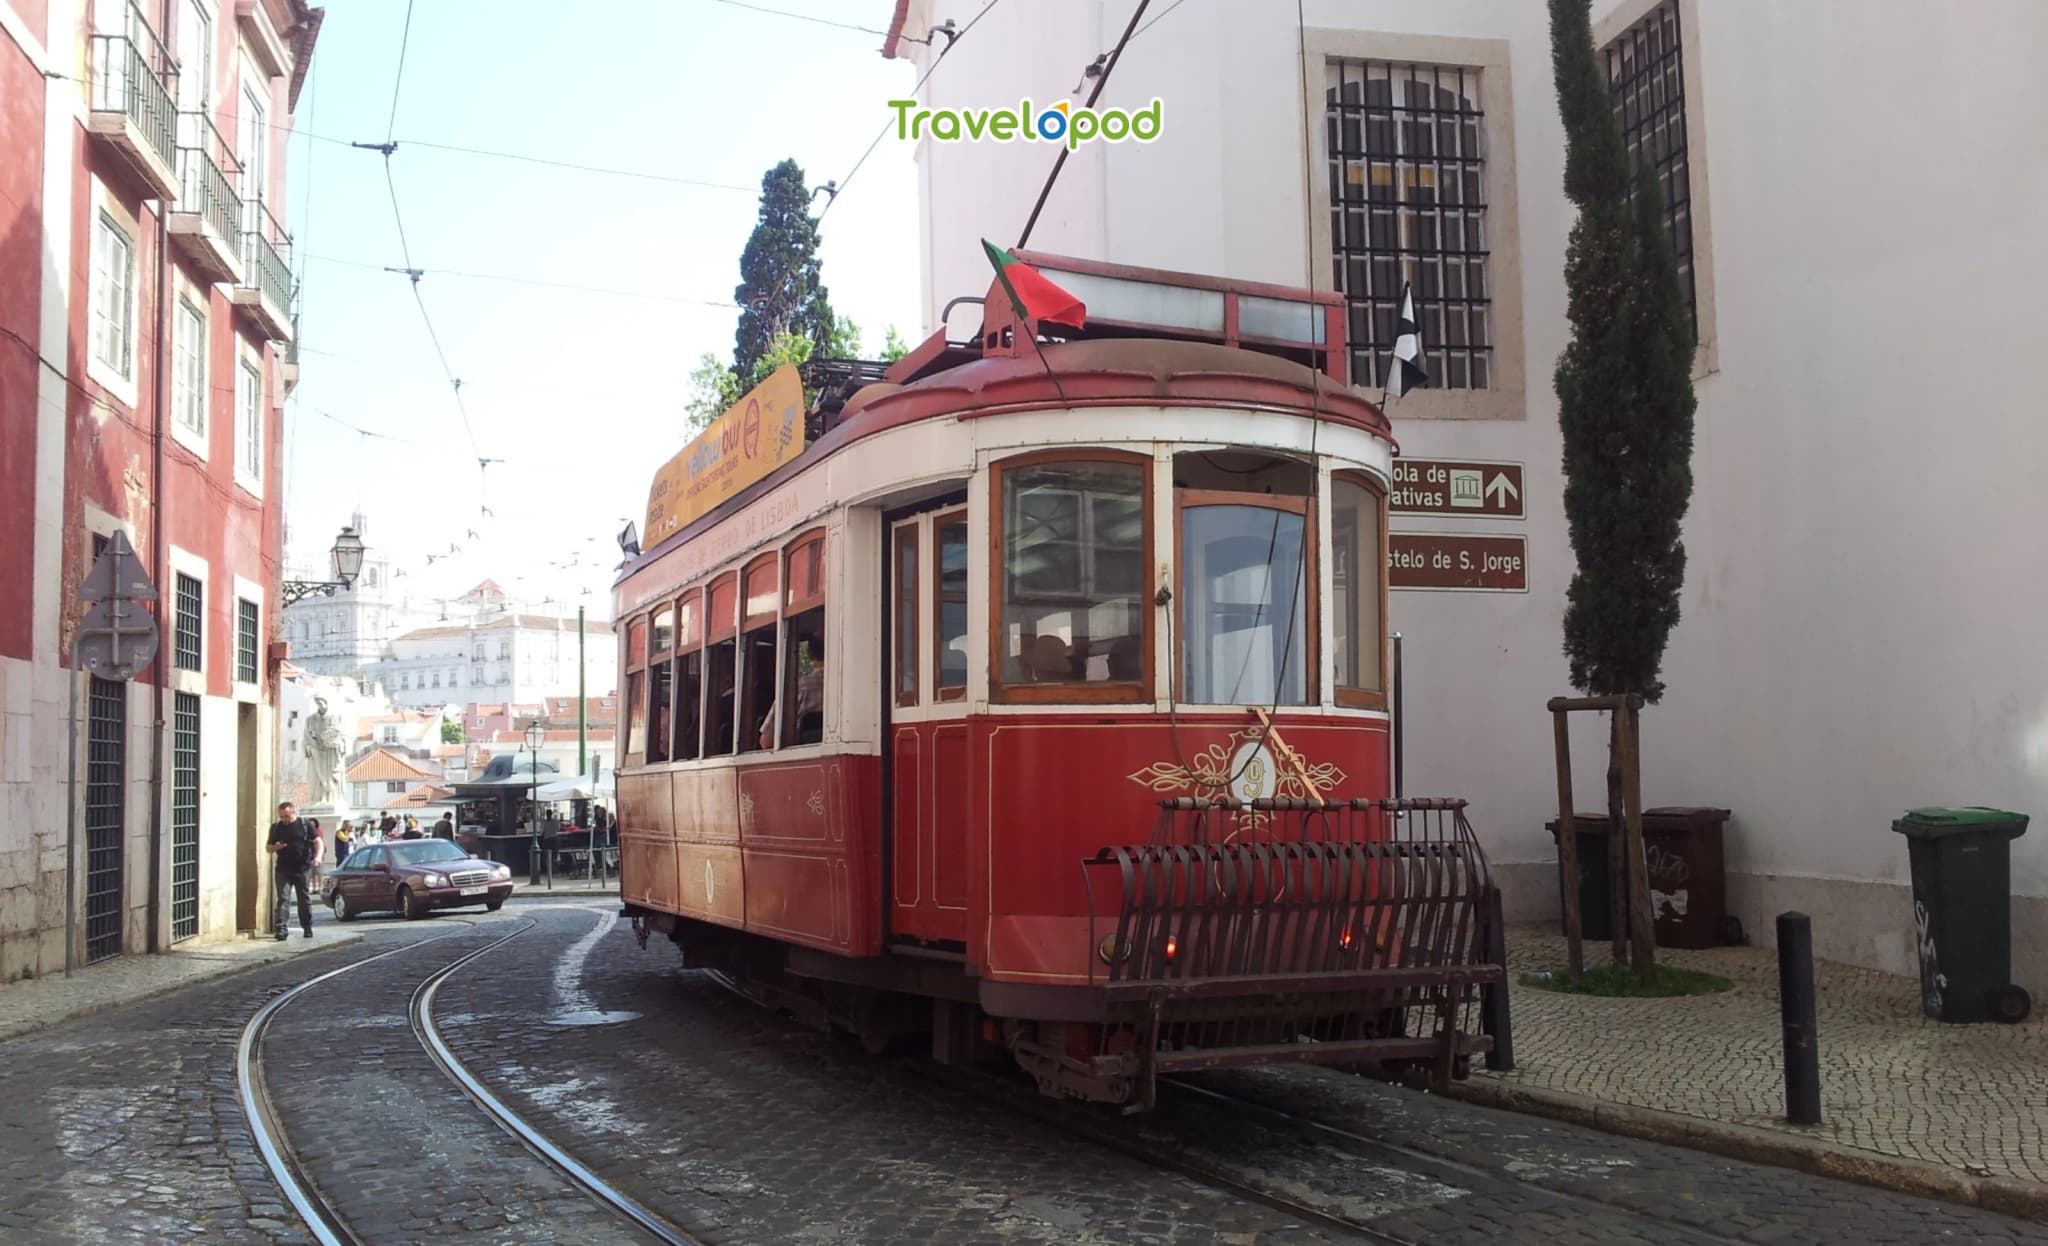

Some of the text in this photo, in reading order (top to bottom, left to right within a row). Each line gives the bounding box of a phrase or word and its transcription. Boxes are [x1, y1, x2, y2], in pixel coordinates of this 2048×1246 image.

[1427, 464, 1447, 483] de
[761, 491, 799, 531] LISBOA
[1432, 550, 1452, 569] de
[1459, 550, 1475, 570] S.
[1481, 551, 1521, 574] Jorge
[1243, 757, 1265, 798] 9
